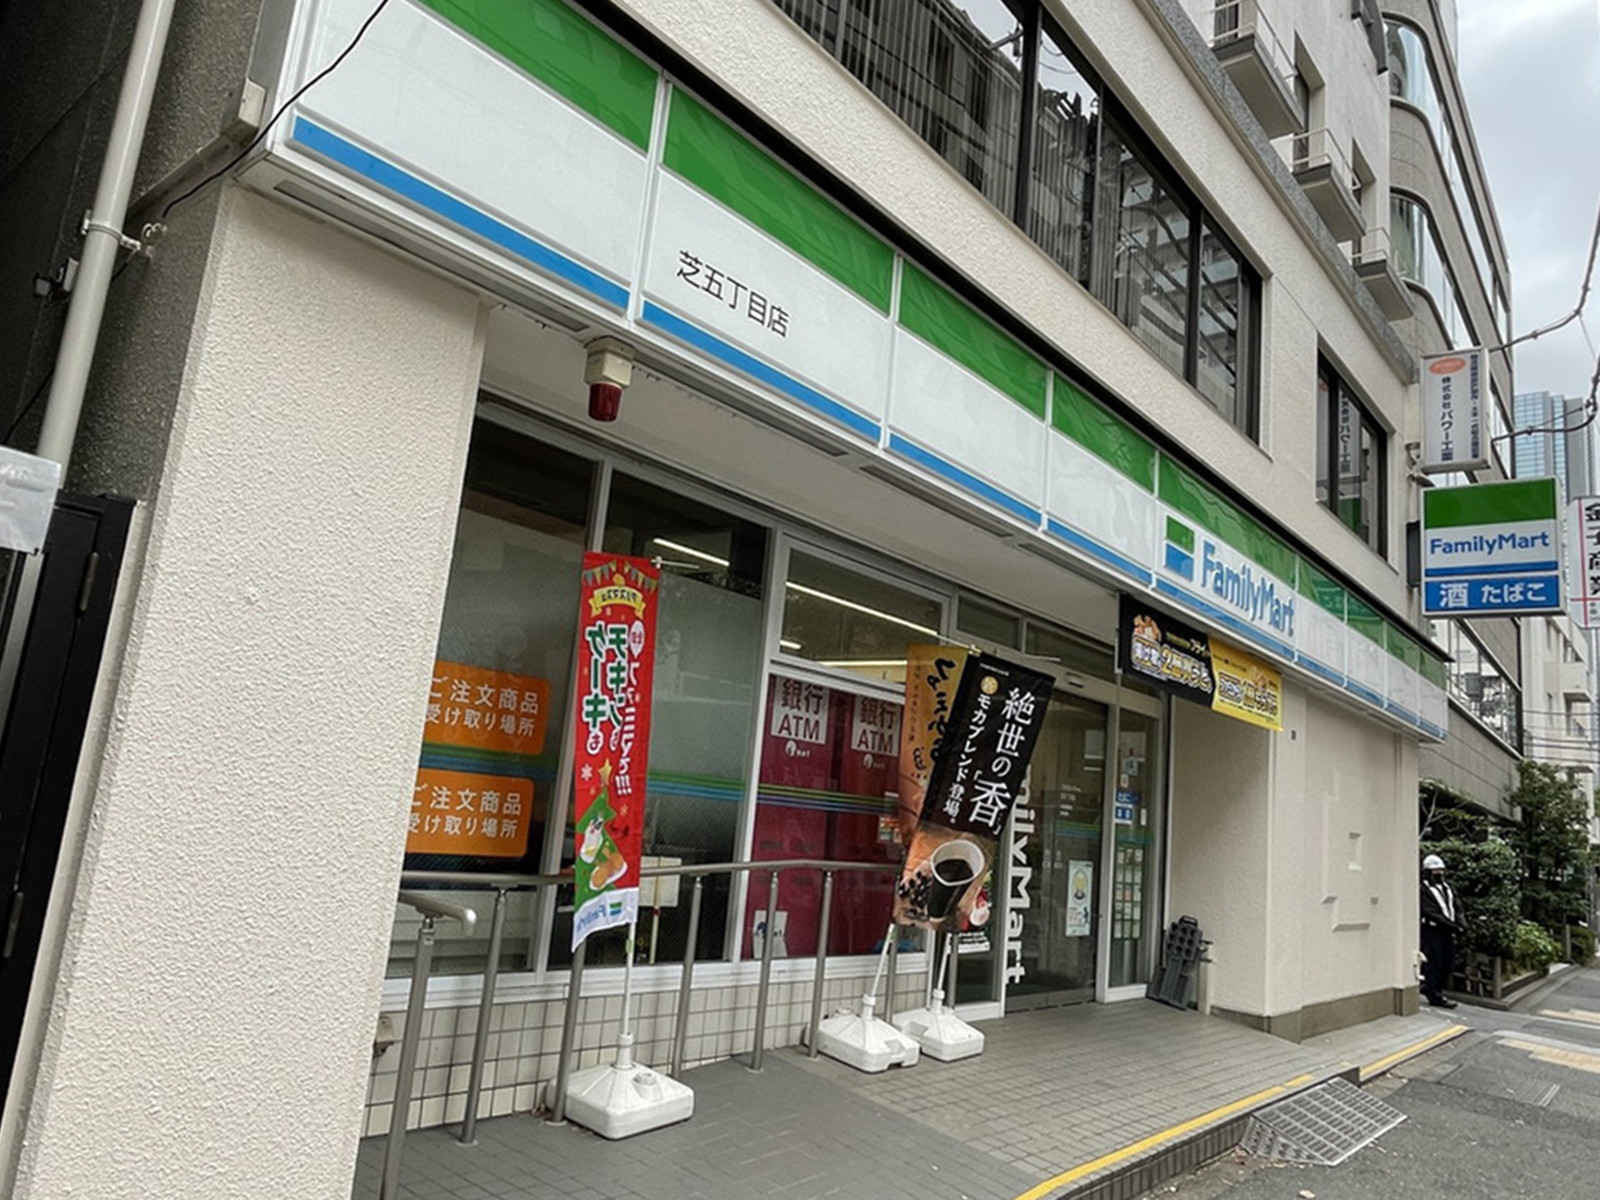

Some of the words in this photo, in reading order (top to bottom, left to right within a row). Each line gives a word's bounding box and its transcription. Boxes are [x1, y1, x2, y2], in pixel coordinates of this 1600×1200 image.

[677, 250, 790, 338] 芝五丁目店
[1430, 531, 1550, 556] FamilyMart
[1201, 540, 1295, 638] FamilyMart
[1439, 582, 1469, 608] 酒
[1481, 582, 1547, 604] たばこ
[781, 679, 824, 715] 銀行
[778, 713, 820, 741] ATM
[859, 696, 897, 730] 銀行
[857, 729, 894, 754] ATM
